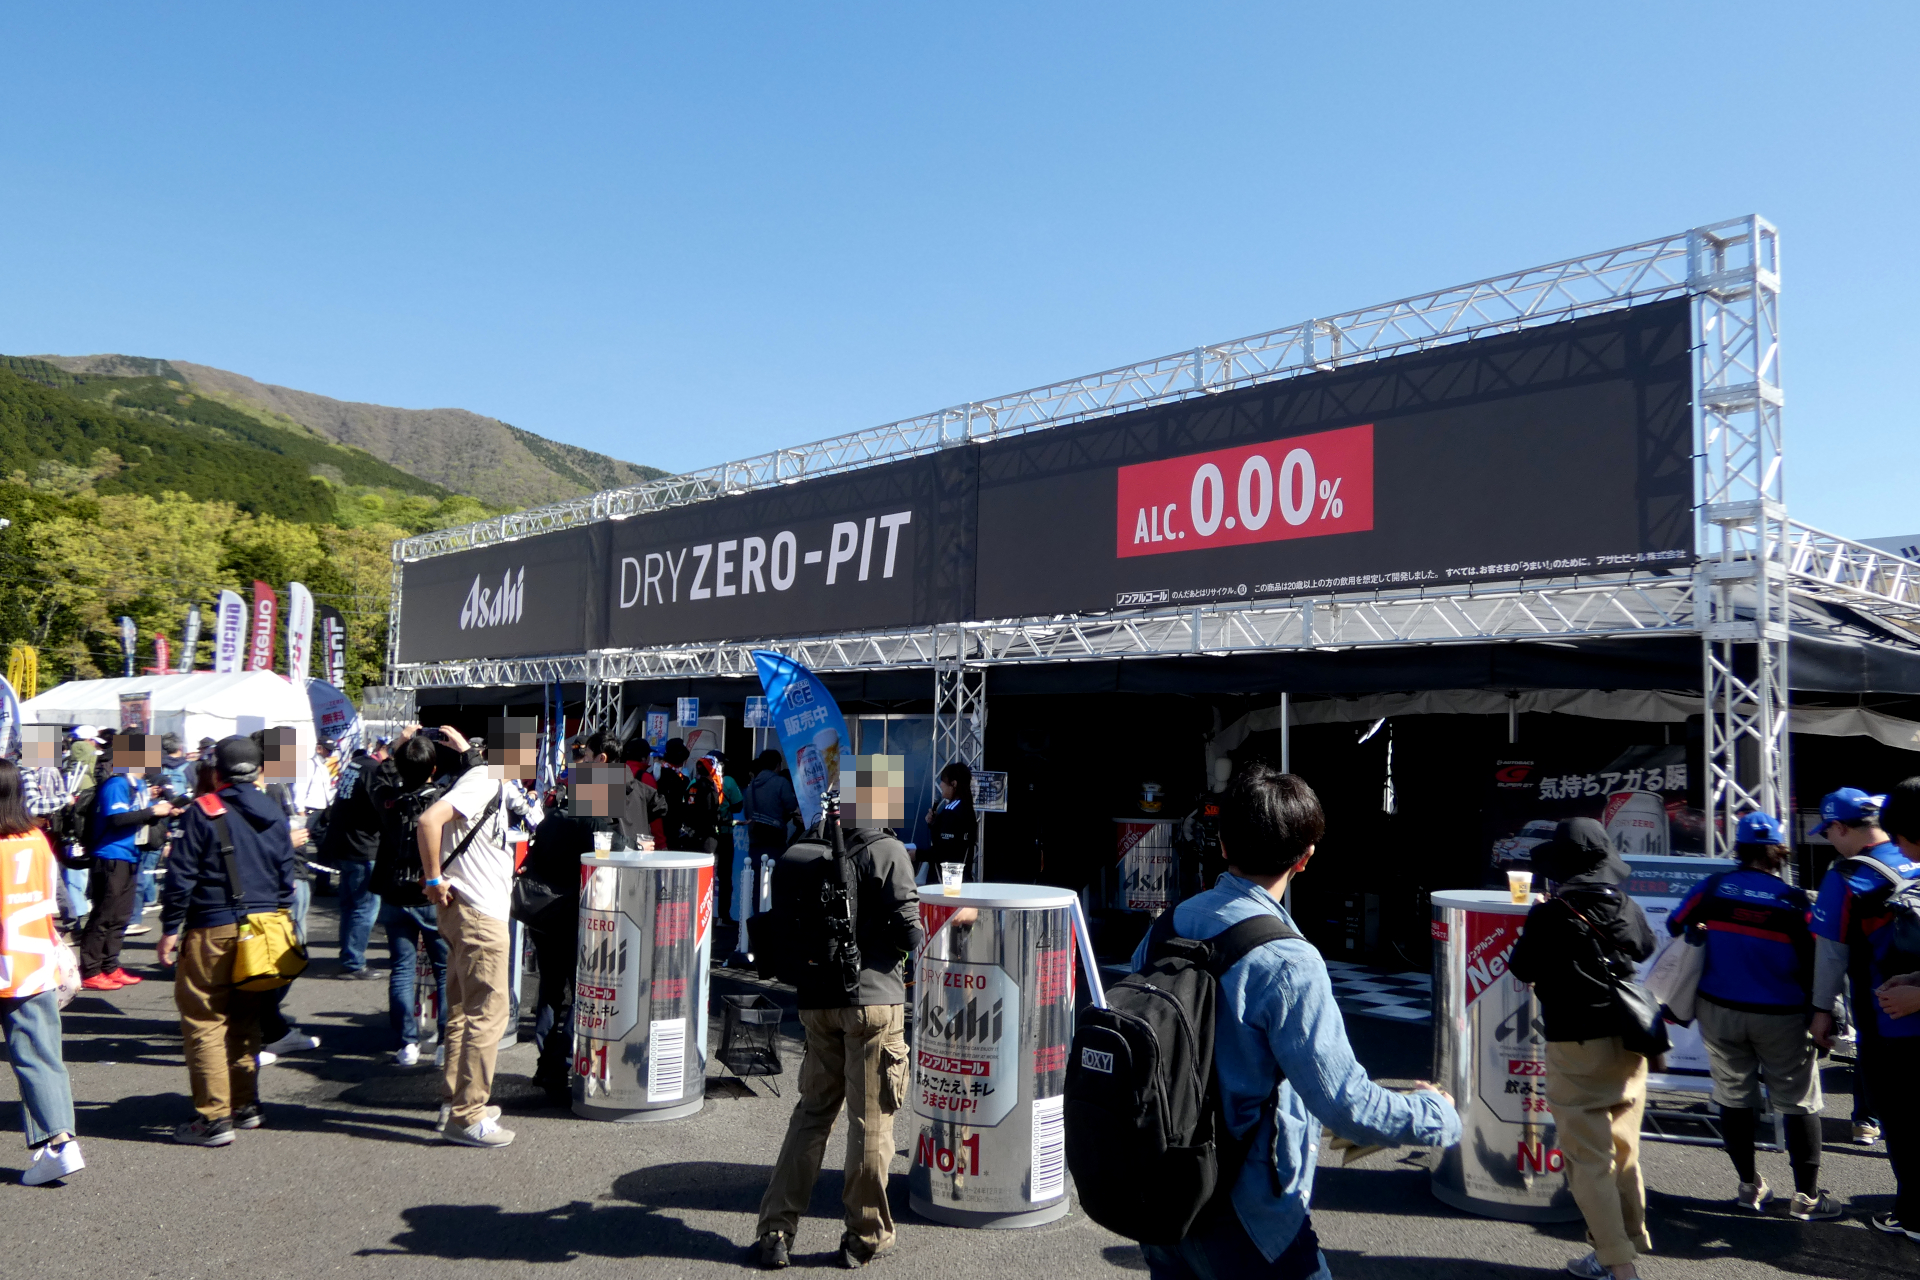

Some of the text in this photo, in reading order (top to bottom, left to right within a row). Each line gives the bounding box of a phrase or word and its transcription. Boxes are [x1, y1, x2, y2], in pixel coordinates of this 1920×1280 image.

[1134, 447, 1343, 545] ALC. 0.00%
[460, 565, 525, 631] Asahi
[1117, 592, 1168, 604] ノンアルコール
[786, 685, 814, 710] ICE
[784, 705, 828, 737] 販売中
[1538, 763, 1688, 800] 気持ちアガる瞬
[579, 937, 628, 976] sahi
[1467, 927, 1505, 963] ノンアルコール
[919, 1054, 984, 1075] ノンアルコール
[919, 1133, 980, 1177] No.1
